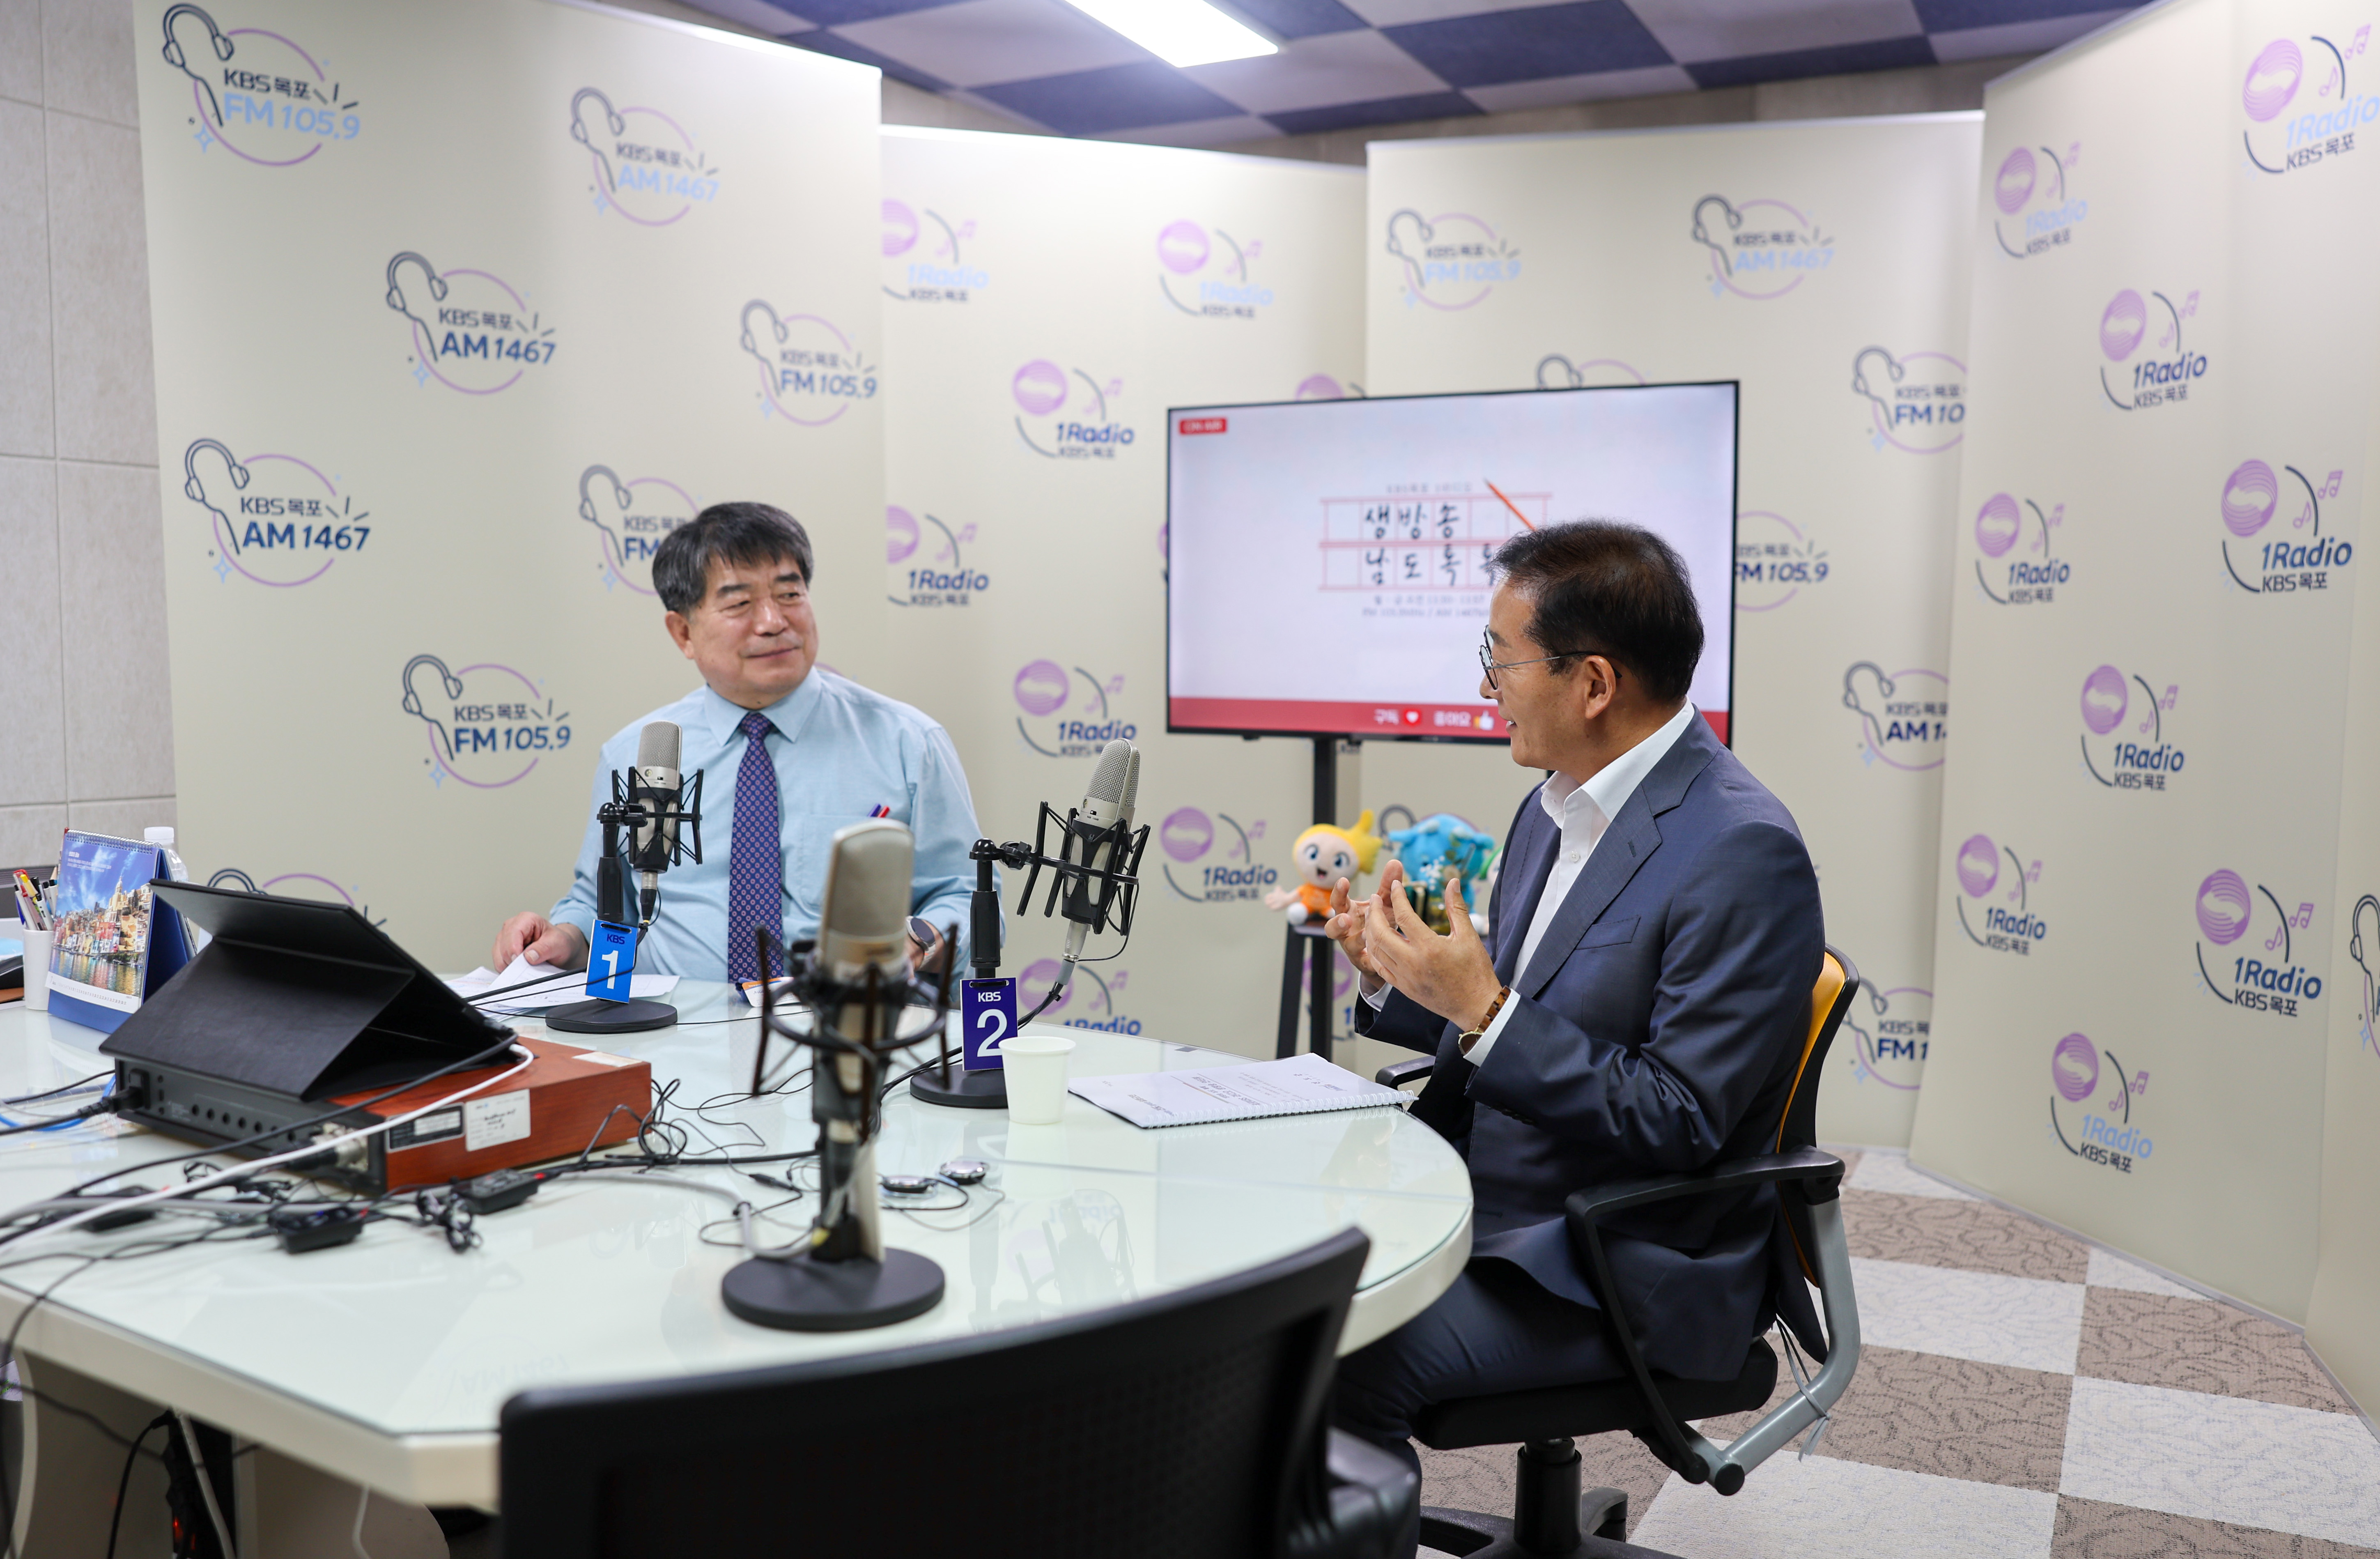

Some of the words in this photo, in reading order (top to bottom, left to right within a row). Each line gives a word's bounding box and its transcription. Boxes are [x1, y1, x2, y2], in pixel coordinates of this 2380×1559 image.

[224, 69, 311, 101] KBS목포
[224, 93, 274, 128] FM
[282, 104, 361, 140] 105.9
[2286, 94, 2380, 149] 1Radio
[2287, 134, 2354, 171] KBS목포
[618, 165, 661, 194] AM
[666, 174, 720, 202] 1467
[2027, 199, 2088, 238] 1Radio
[1425, 262, 1459, 284] FM
[1734, 250, 1775, 273] AM
[439, 308, 512, 329] KBS목포
[441, 332, 488, 359] AM
[495, 338, 556, 364] 1467
[781, 370, 814, 393] FM
[821, 375, 877, 398] 105.9
[2135, 353, 2206, 388] 1Radio
[1895, 404, 1931, 424] FM
[1057, 425, 1133, 444] 1Radio
[241, 498, 322, 517] KBS목포
[1365, 503, 1459, 539] 생방송
[243, 522, 295, 549] AM
[303, 525, 370, 551] 1467
[2262, 538, 2351, 570] 1Radio
[908, 572, 988, 591] 1Radio
[1768, 562, 1829, 583] 105.9
[2009, 561, 2069, 584] 1Radio
[2262, 574, 2327, 593] KBS목포
[454, 705, 528, 722] KBS목포
[454, 727, 496, 753] FM
[503, 726, 571, 750] 105.9
[1059, 721, 1136, 739] 1Radio
[1887, 721, 1927, 741] AM
[2114, 744, 2183, 771] 1Radio
[2114, 773, 2165, 790] KBS목포
[1204, 865, 1277, 886] 1Radio
[1985, 907, 2046, 940] 1Radio
[606, 934, 625, 945] KBS
[602, 950, 618, 989] 1
[2234, 957, 2321, 1000] 1Radio
[978, 991, 1001, 1002] KBS
[2234, 989, 2298, 1017] KBS목포
[977, 1009, 1007, 1057] 2
[1878, 1038, 1915, 1060] FM
[2081, 1114, 2153, 1159] 1Radio
[2080, 1142, 2132, 1173] KBS목포
